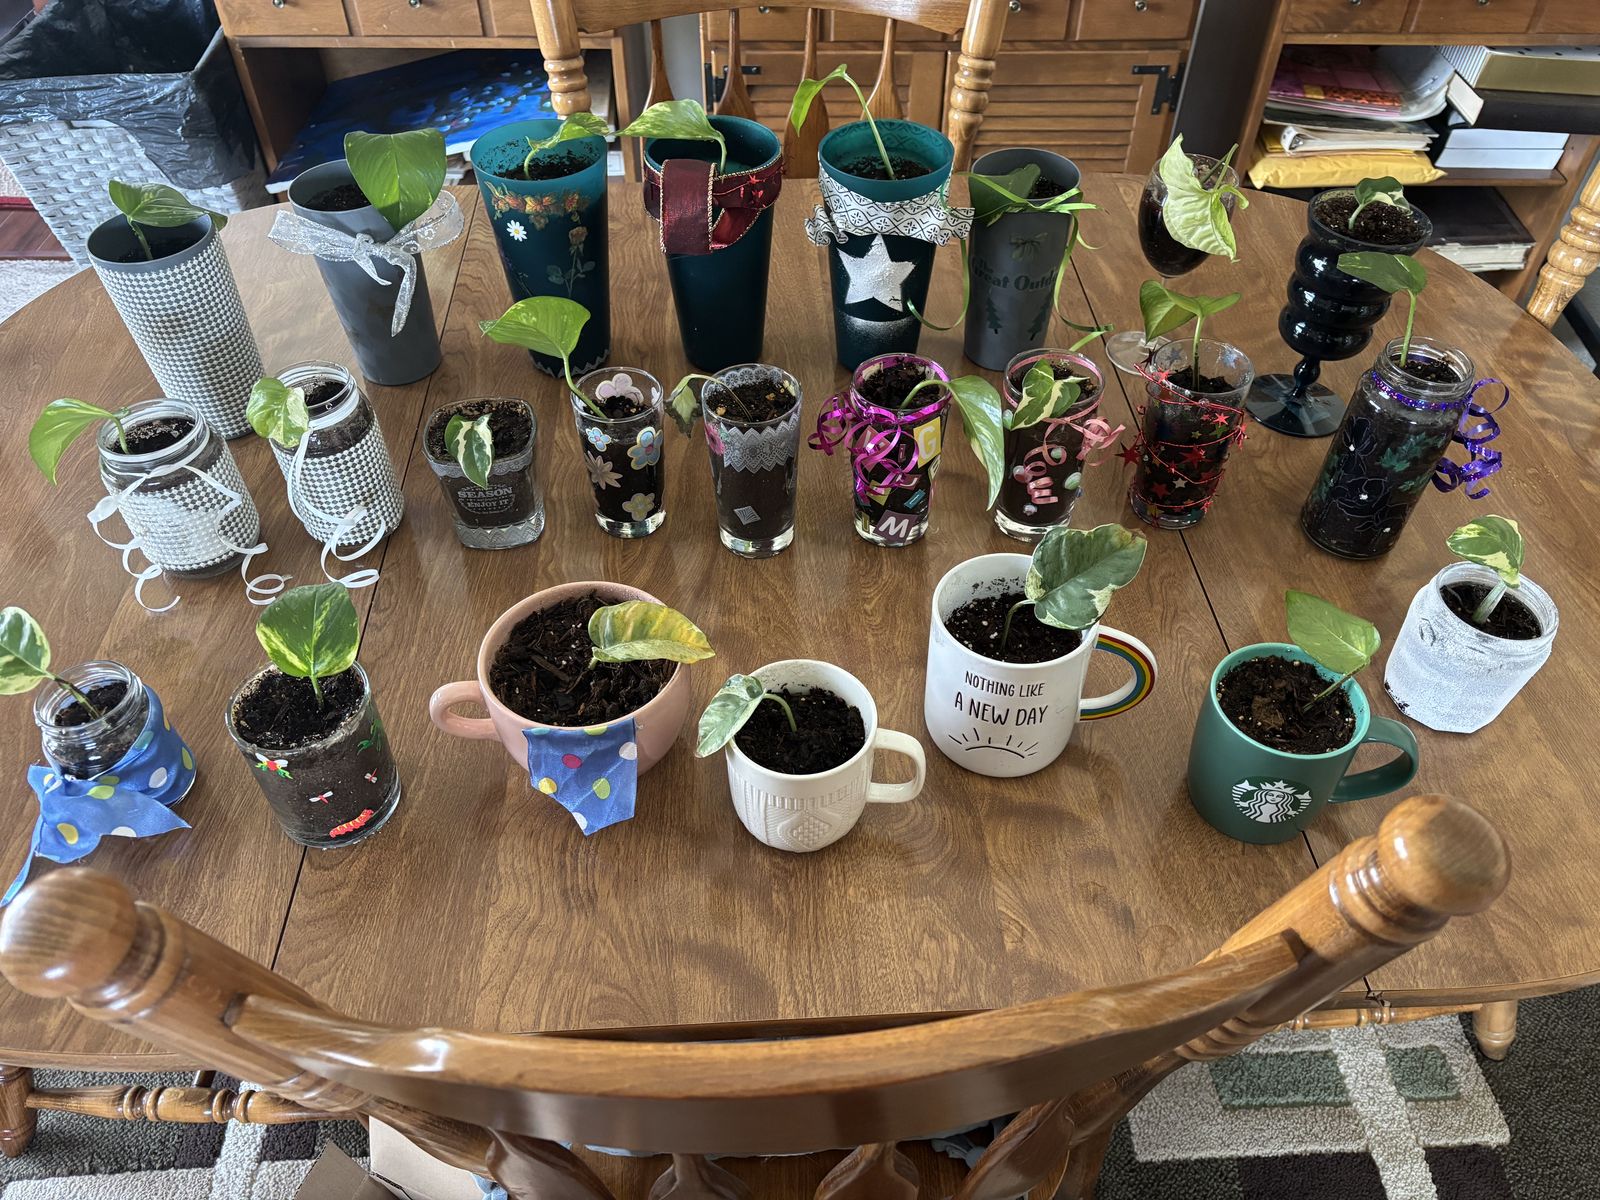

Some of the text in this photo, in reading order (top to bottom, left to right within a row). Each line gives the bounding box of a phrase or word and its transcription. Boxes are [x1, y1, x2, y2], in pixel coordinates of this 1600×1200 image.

[919, 426, 937, 460] G
[457, 486, 513, 499] SEASON
[467, 500, 497, 508] ENJOY
[499, 498, 509, 506] IT
[878, 516, 910, 538] M
[964, 670, 1046, 698] NOTHING LIKE
[954, 691, 1048, 726] A NEW DAY
